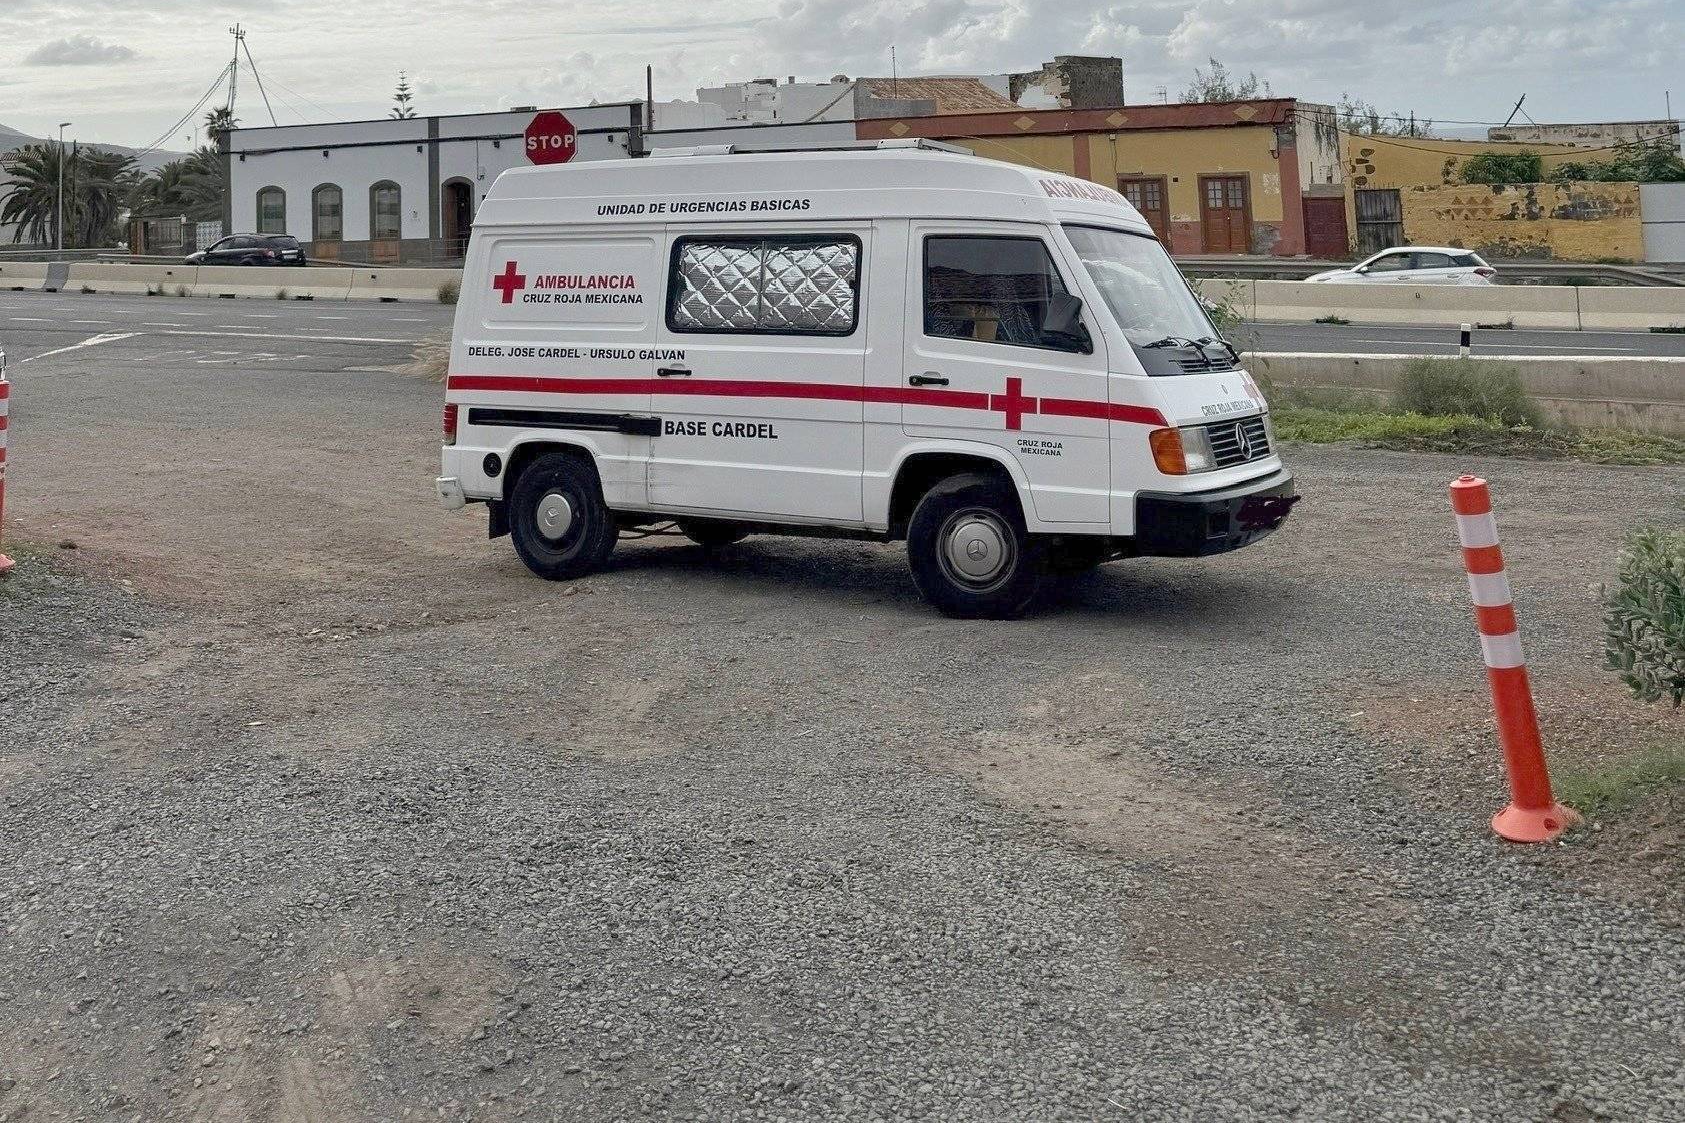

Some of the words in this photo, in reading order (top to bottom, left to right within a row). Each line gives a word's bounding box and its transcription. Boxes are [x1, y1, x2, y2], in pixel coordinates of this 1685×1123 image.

[527, 134, 574, 150] STOP
[597, 203, 645, 216] UNIDAD
[649, 202, 667, 214] DE
[669, 200, 747, 214] URGENCIAS
[750, 198, 811, 212] BASICAS
[534, 275, 635, 289] AMBULANCIA
[523, 293, 551, 304] CRUZ
[554, 293, 582, 304] ROJA
[585, 294, 643, 304] MEXICANA
[468, 346, 505, 358] DELEG.
[508, 347, 535, 358] JOSE
[538, 347, 580, 359] CARDEL
[590, 349, 636, 360] URSULO
[639, 349, 685, 361] GALVAN
[664, 420, 707, 436] BASE
[712, 422, 778, 439] CARDEL
[1017, 439, 1038, 447] CRUZ
[1041, 441, 1063, 449] ROJA
[1020, 447, 1062, 456] MEXICANA
